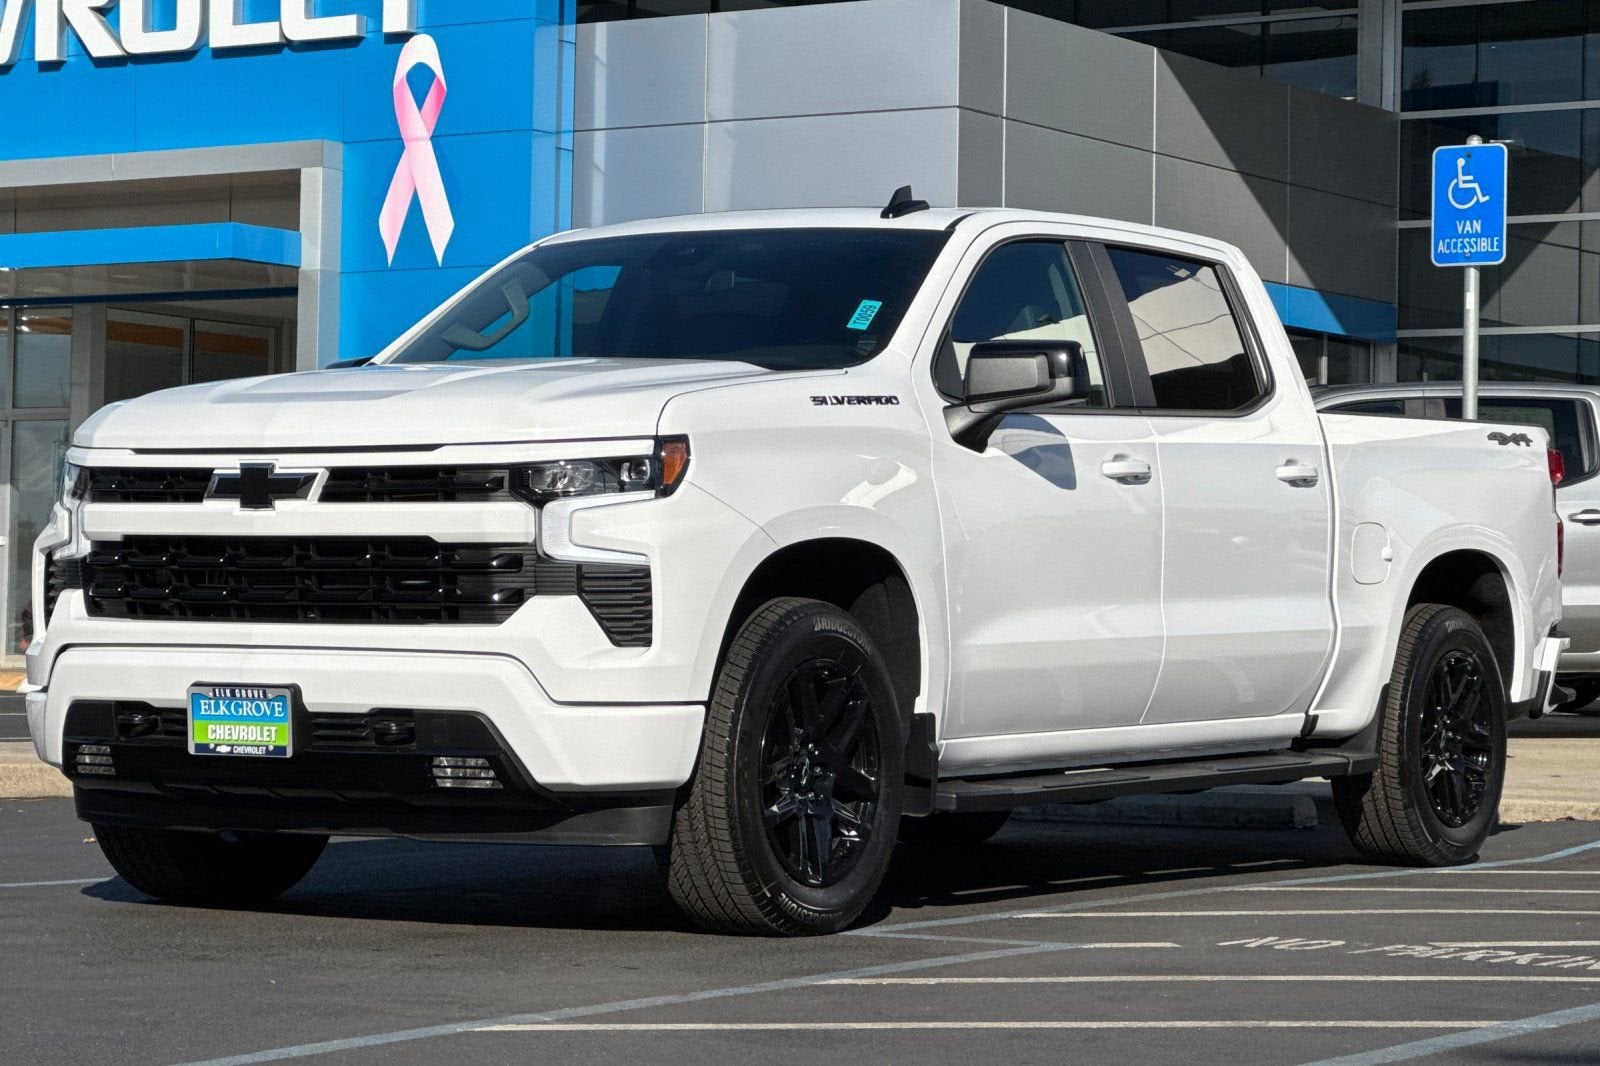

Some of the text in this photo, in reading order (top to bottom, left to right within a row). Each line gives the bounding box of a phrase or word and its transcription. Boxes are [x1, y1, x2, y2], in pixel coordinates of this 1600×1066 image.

[1456, 219, 1482, 235] VAN
[1437, 237, 1500, 254] ACCESSIBLE
[809, 395, 900, 406] SILVERADO
[215, 688, 265, 699] ELK GROVE
[207, 724, 278, 743] CHEVROLET
[232, 745, 267, 755] CHEVROLET
[1215, 936, 1346, 951] NO
